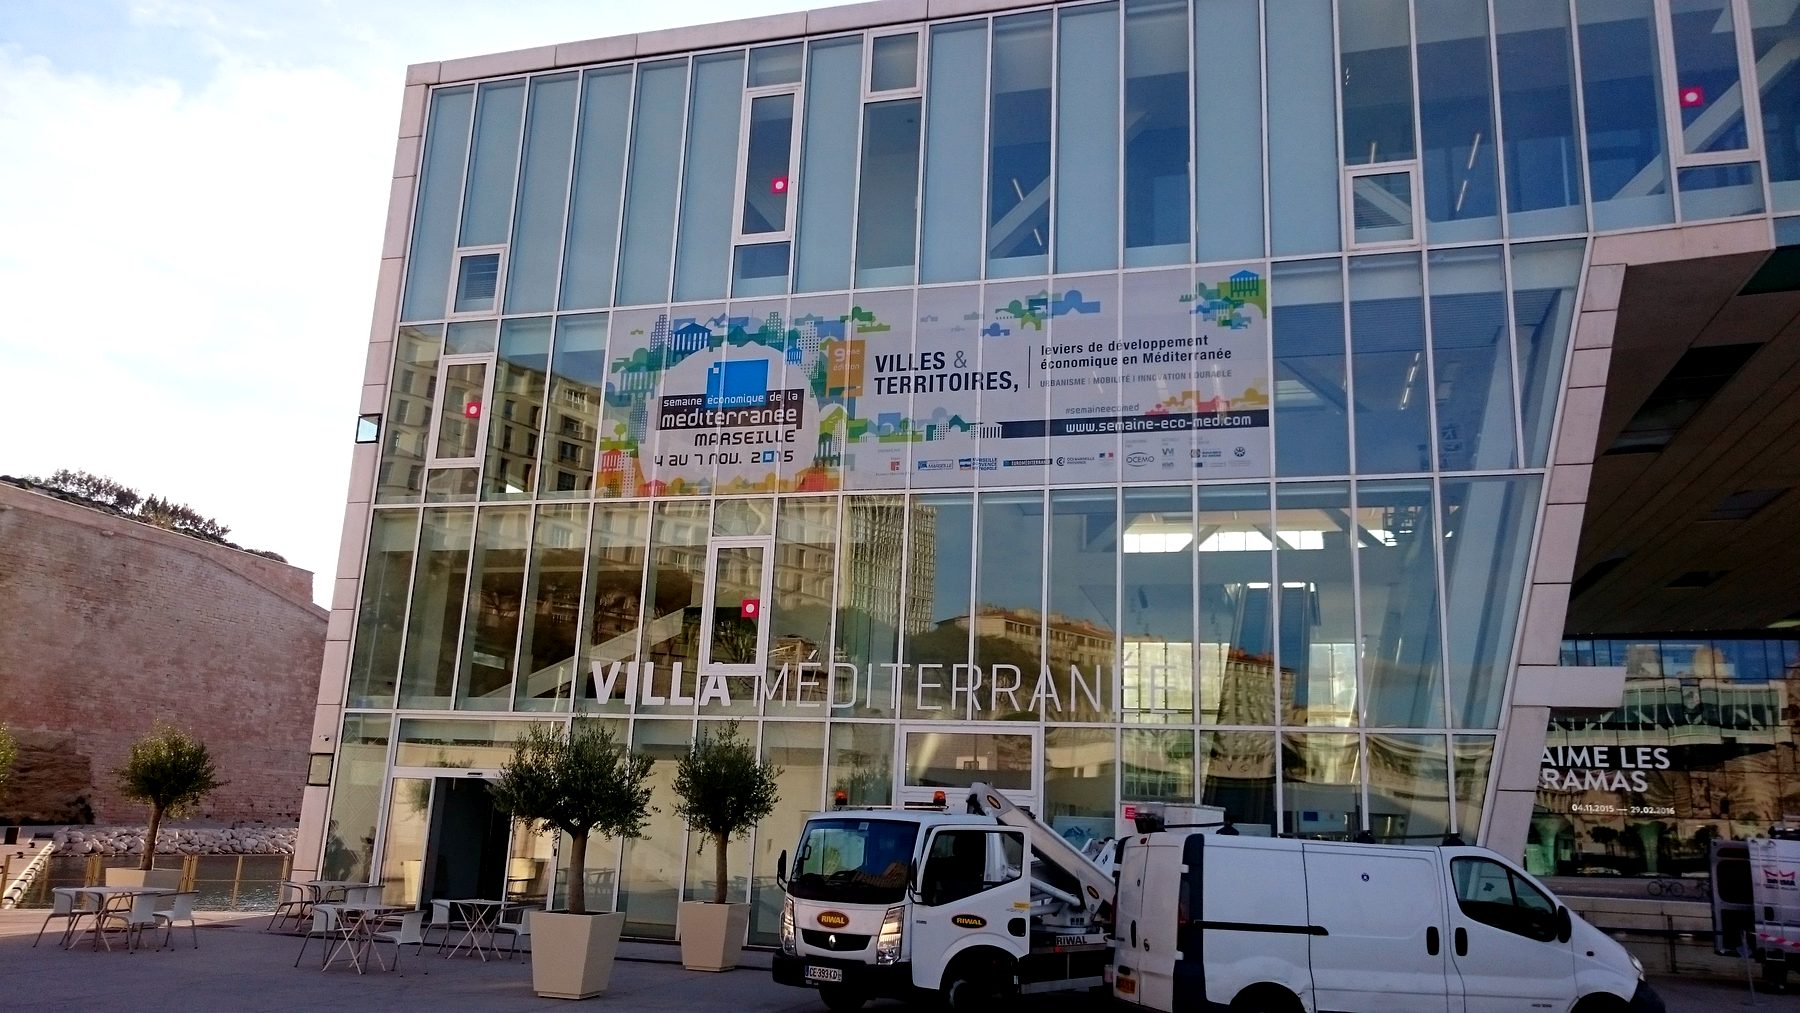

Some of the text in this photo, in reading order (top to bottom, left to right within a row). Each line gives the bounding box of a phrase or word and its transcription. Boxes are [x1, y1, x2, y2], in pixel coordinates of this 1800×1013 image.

[1041, 335, 1208, 355] leviers de développement
[875, 351, 967, 373] VILLES &
[1040, 348, 1232, 370] économique en Méditerranée
[874, 371, 1019, 395] TERRITOIRES,
[1040, 377, 1086, 388] URBANISME
[1138, 372, 1186, 382] INNOVATION
[663, 391, 798, 407] semaine économique de la
[1065, 403, 1140, 414] #semaineecomed
[1065, 414, 1252, 433] www.semaine-eco-med.com
[694, 429, 796, 447] MARSEILLE
[654, 455, 663, 466] 4
[695, 454, 703, 465] 7
[1126, 456, 1154, 464] OCEMO
[591, 649, 1178, 714] VILLA MÉDITERRANÉE
[1620, 747, 1670, 769] LES
[1571, 803, 1614, 813] 04.11.2015
[1630, 805, 1675, 815] 29.02.2016
[821, 915, 845, 924] RIWAL
[956, 917, 982, 926] RIWAL
[1056, 935, 1087, 946] RIWAL
